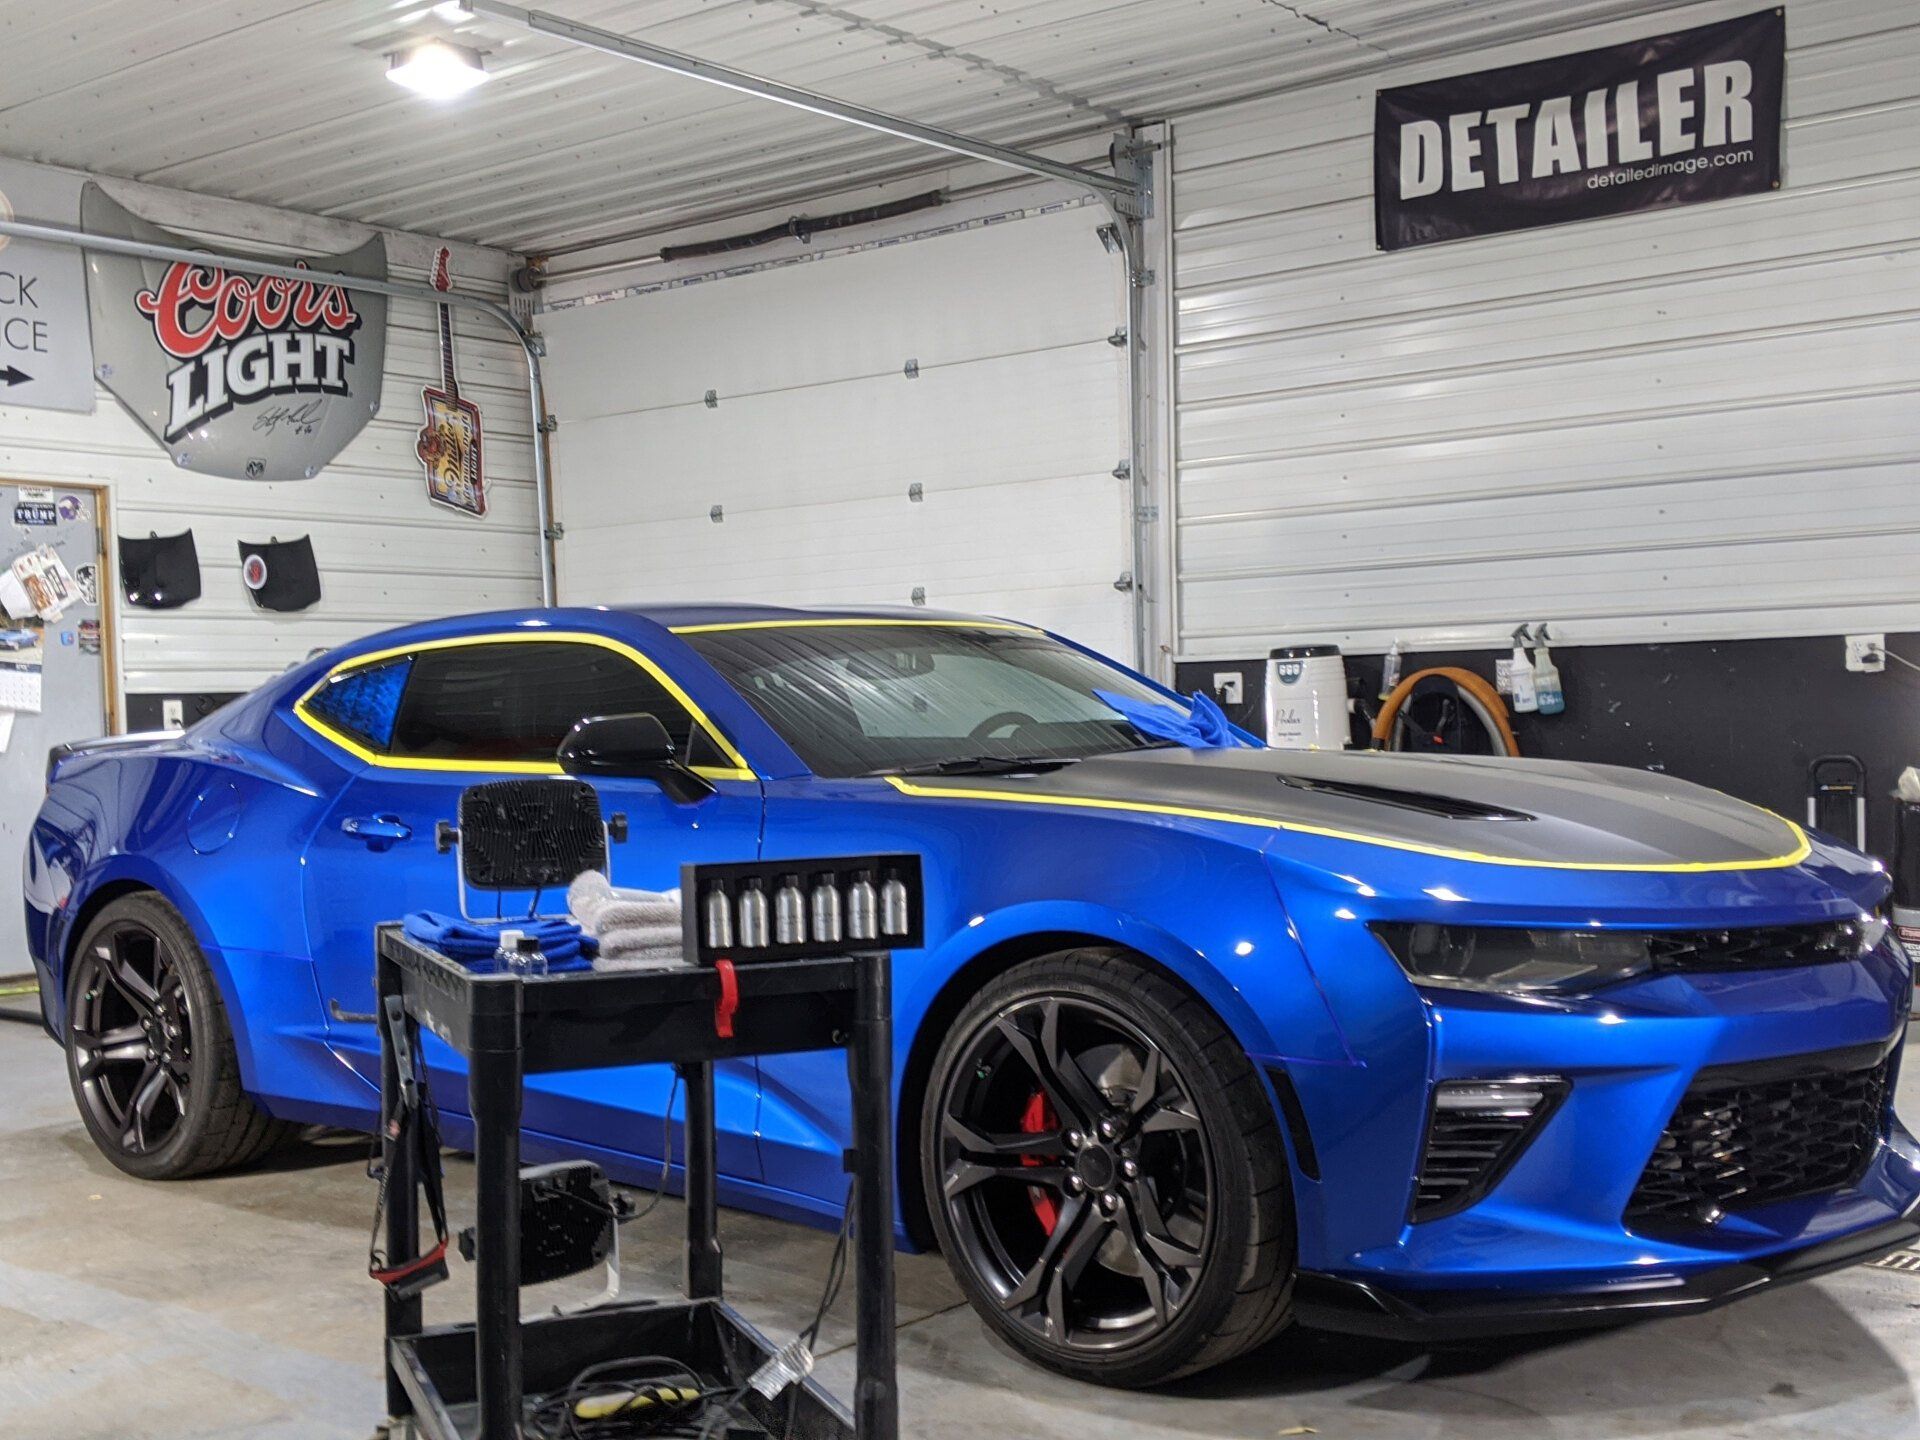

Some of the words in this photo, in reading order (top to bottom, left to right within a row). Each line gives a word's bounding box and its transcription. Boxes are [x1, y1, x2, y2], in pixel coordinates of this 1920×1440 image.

[1401, 60, 1753, 200] DETAILER
[1587, 150, 1754, 189] detailedimage.com
[135, 251, 360, 361] Coors
[166, 331, 352, 440] LIGHT
[444, 420, 461, 487] Miller
[461, 415, 471, 448] Draft
[470, 447, 478, 481] LIGHT
[17, 508, 55, 520] TRUMP
